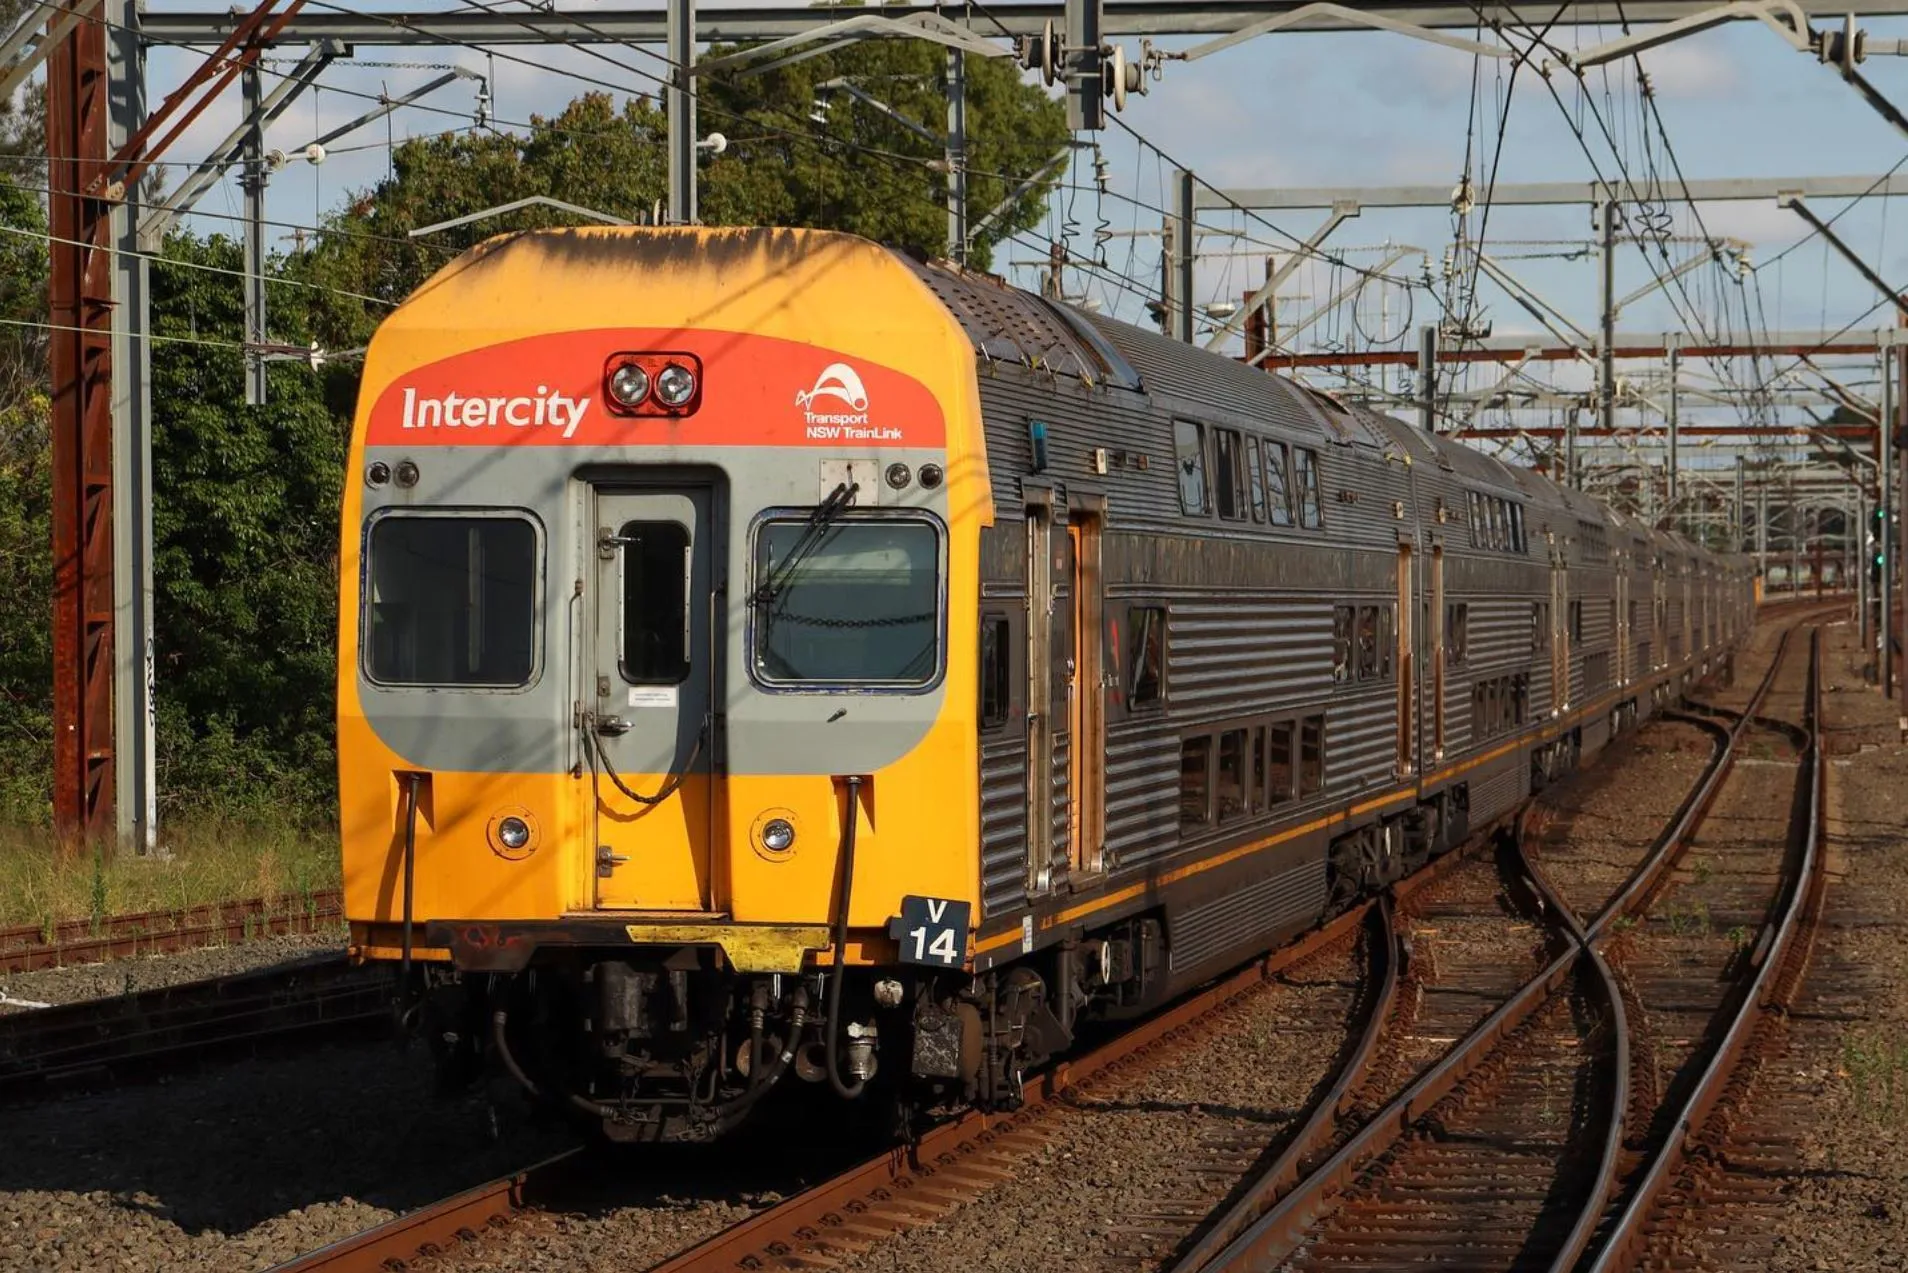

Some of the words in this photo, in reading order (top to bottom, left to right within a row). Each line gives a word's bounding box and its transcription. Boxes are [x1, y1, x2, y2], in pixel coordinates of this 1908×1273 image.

[402, 385, 591, 438] Intercity
[804, 412, 868, 426] Transport
[807, 426, 840, 439] NSW
[843, 427, 902, 439] TrainLink
[927, 899, 947, 924] V
[910, 926, 957, 964] 14
